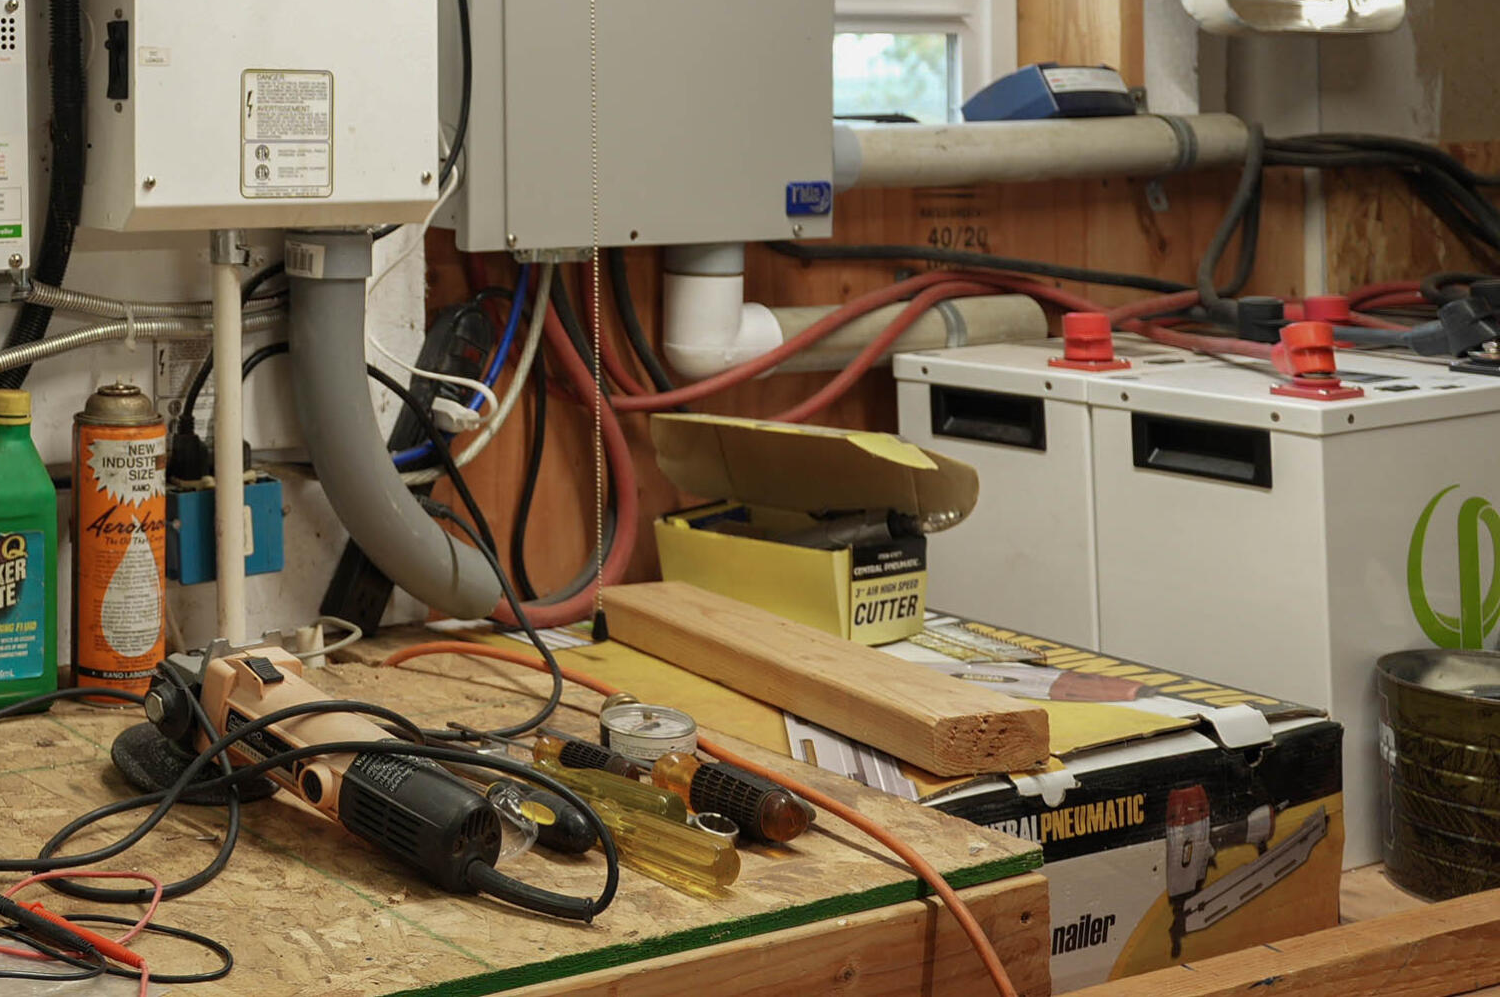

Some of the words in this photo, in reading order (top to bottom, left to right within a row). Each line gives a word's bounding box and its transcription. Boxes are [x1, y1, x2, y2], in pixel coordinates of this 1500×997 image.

[928, 226, 988, 248] 40/20
[128, 444, 155, 455] NEW
[102, 456, 157, 468] INDUSTR
[129, 469, 154, 480] SIZE
[2, 535, 28, 560] Q
[854, 565, 882, 576] CENTRAL
[867, 585, 878, 596] AIR
[881, 583, 896, 593] HIGH
[898, 579, 918, 591] SPEED
[854, 594, 918, 626] CUTTER
[15, 621, 38, 632] FLUID
[1052, 914, 1116, 956] nailer
